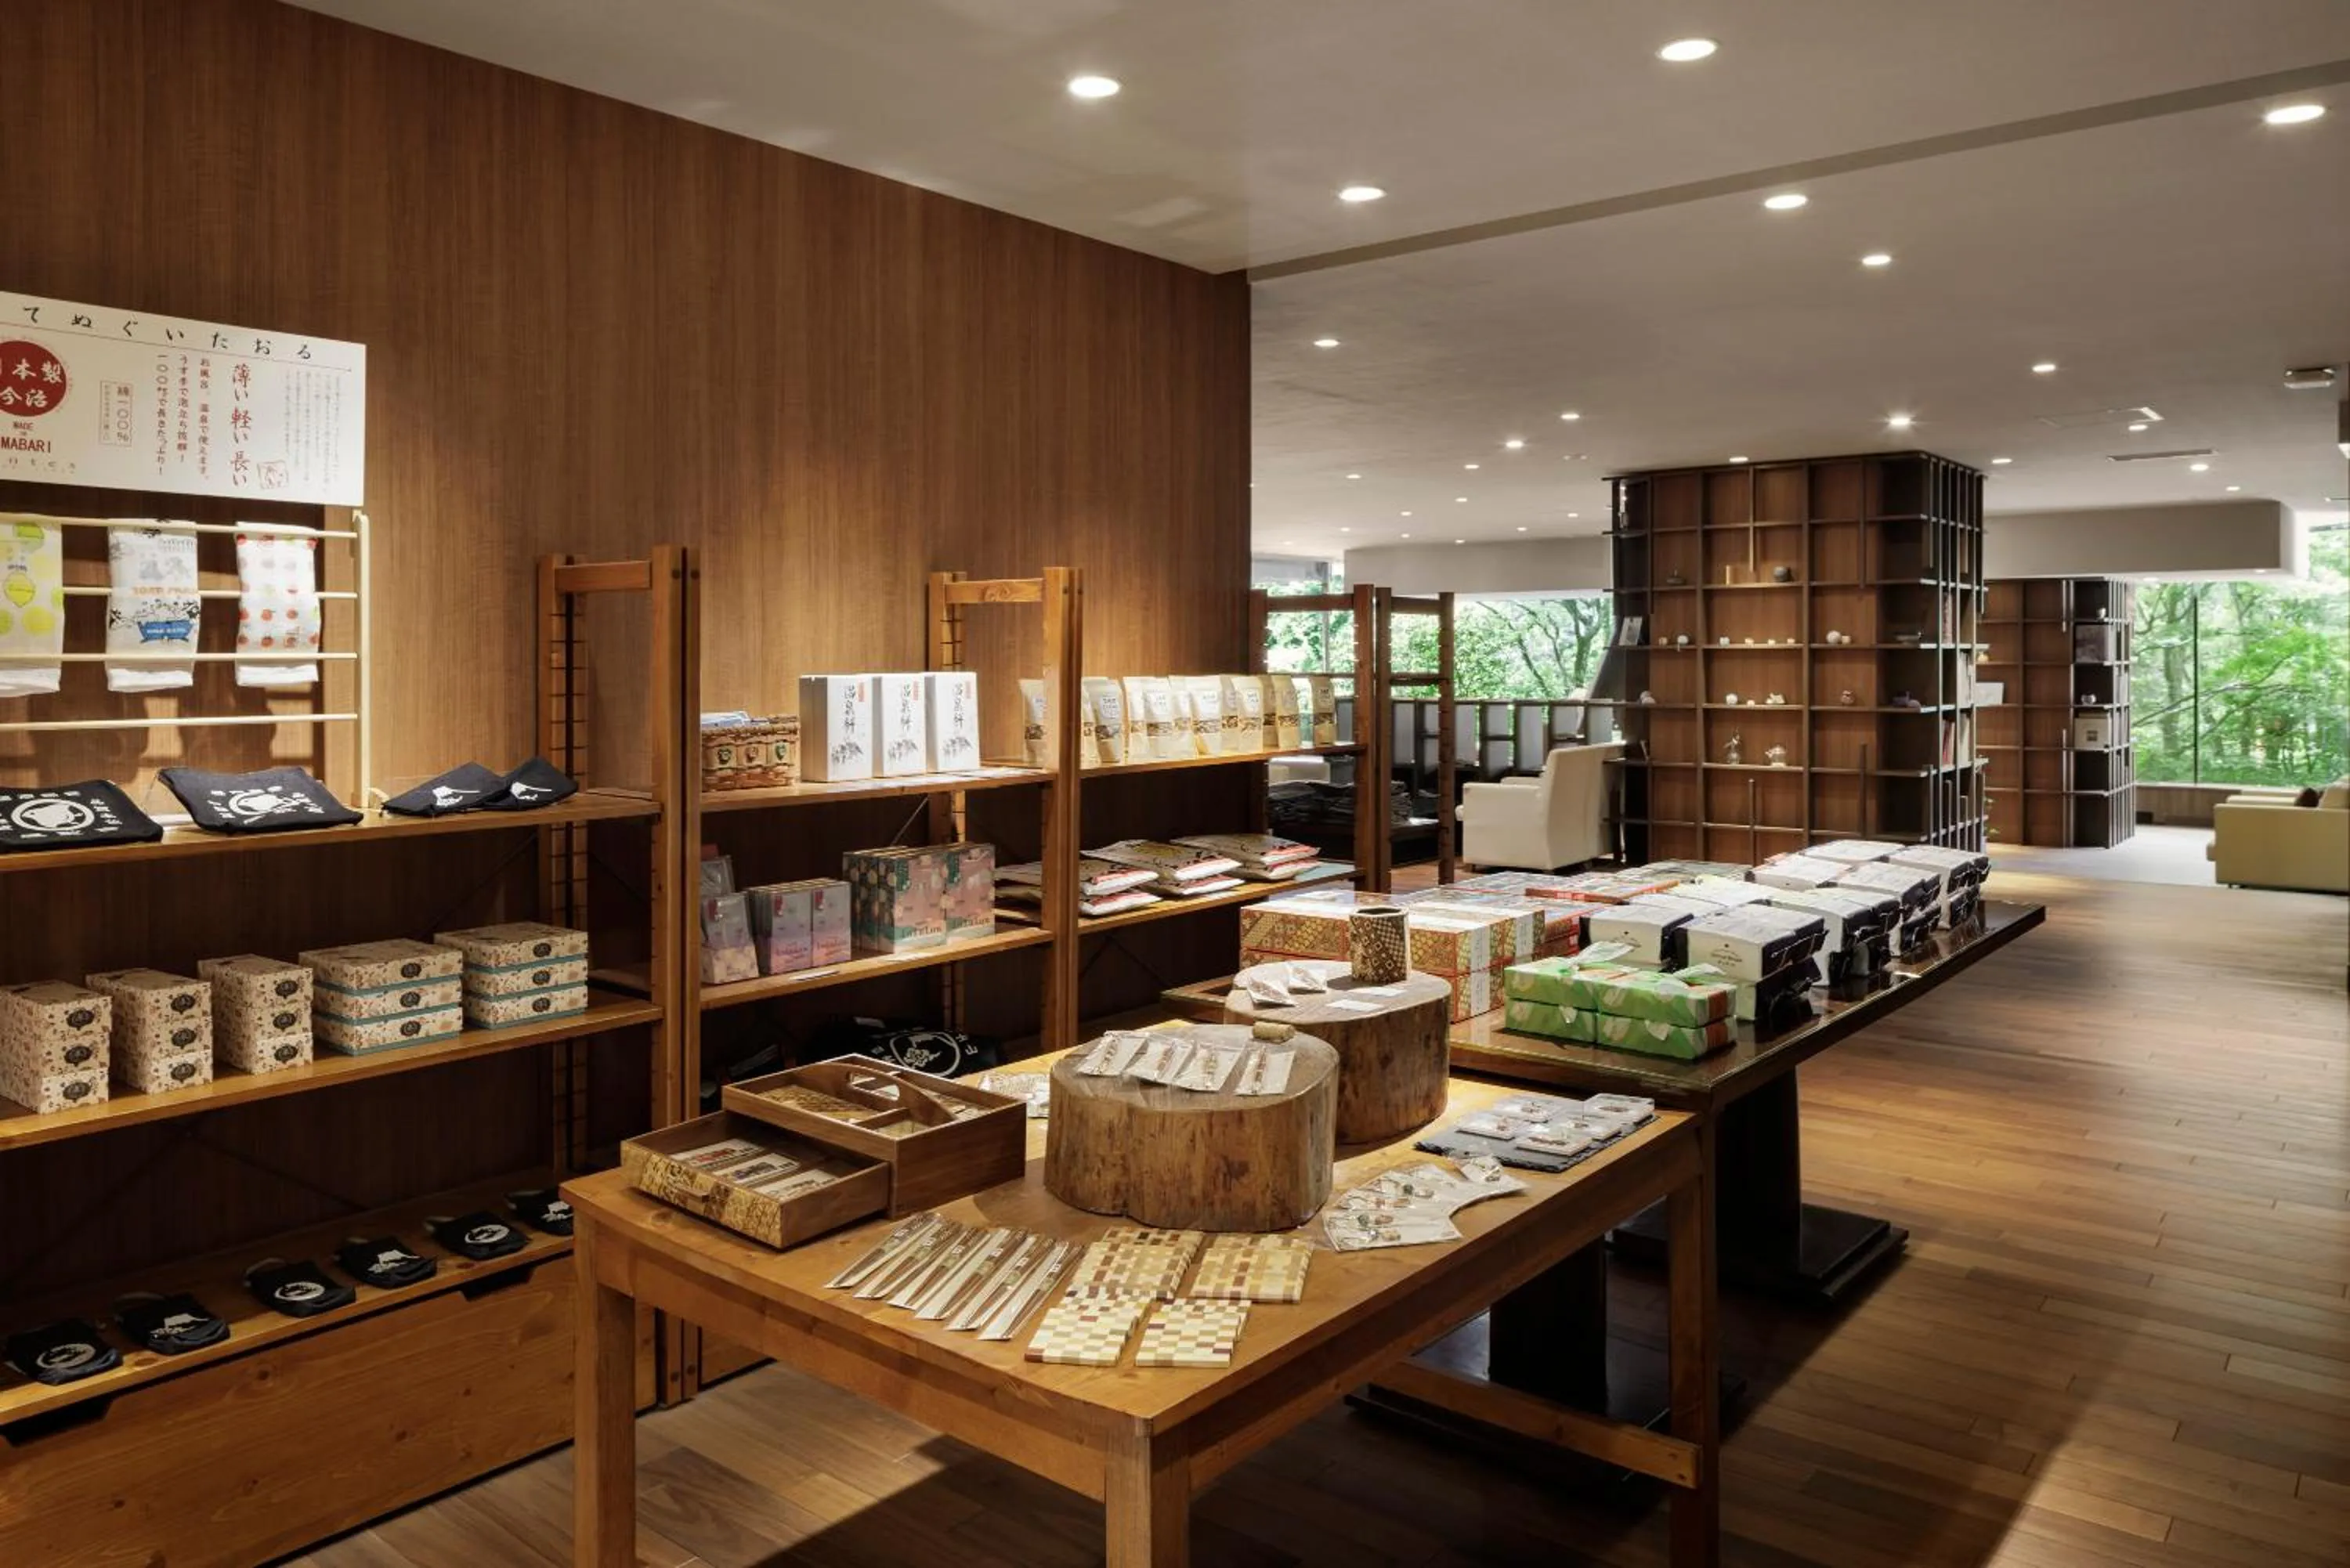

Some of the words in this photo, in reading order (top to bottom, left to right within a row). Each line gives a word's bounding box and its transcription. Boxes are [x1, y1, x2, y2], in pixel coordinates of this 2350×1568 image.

[23, 306, 313, 359] てぬぐいたおる
[0, 359, 63, 384] 本製
[0, 386, 48, 407] 今治
